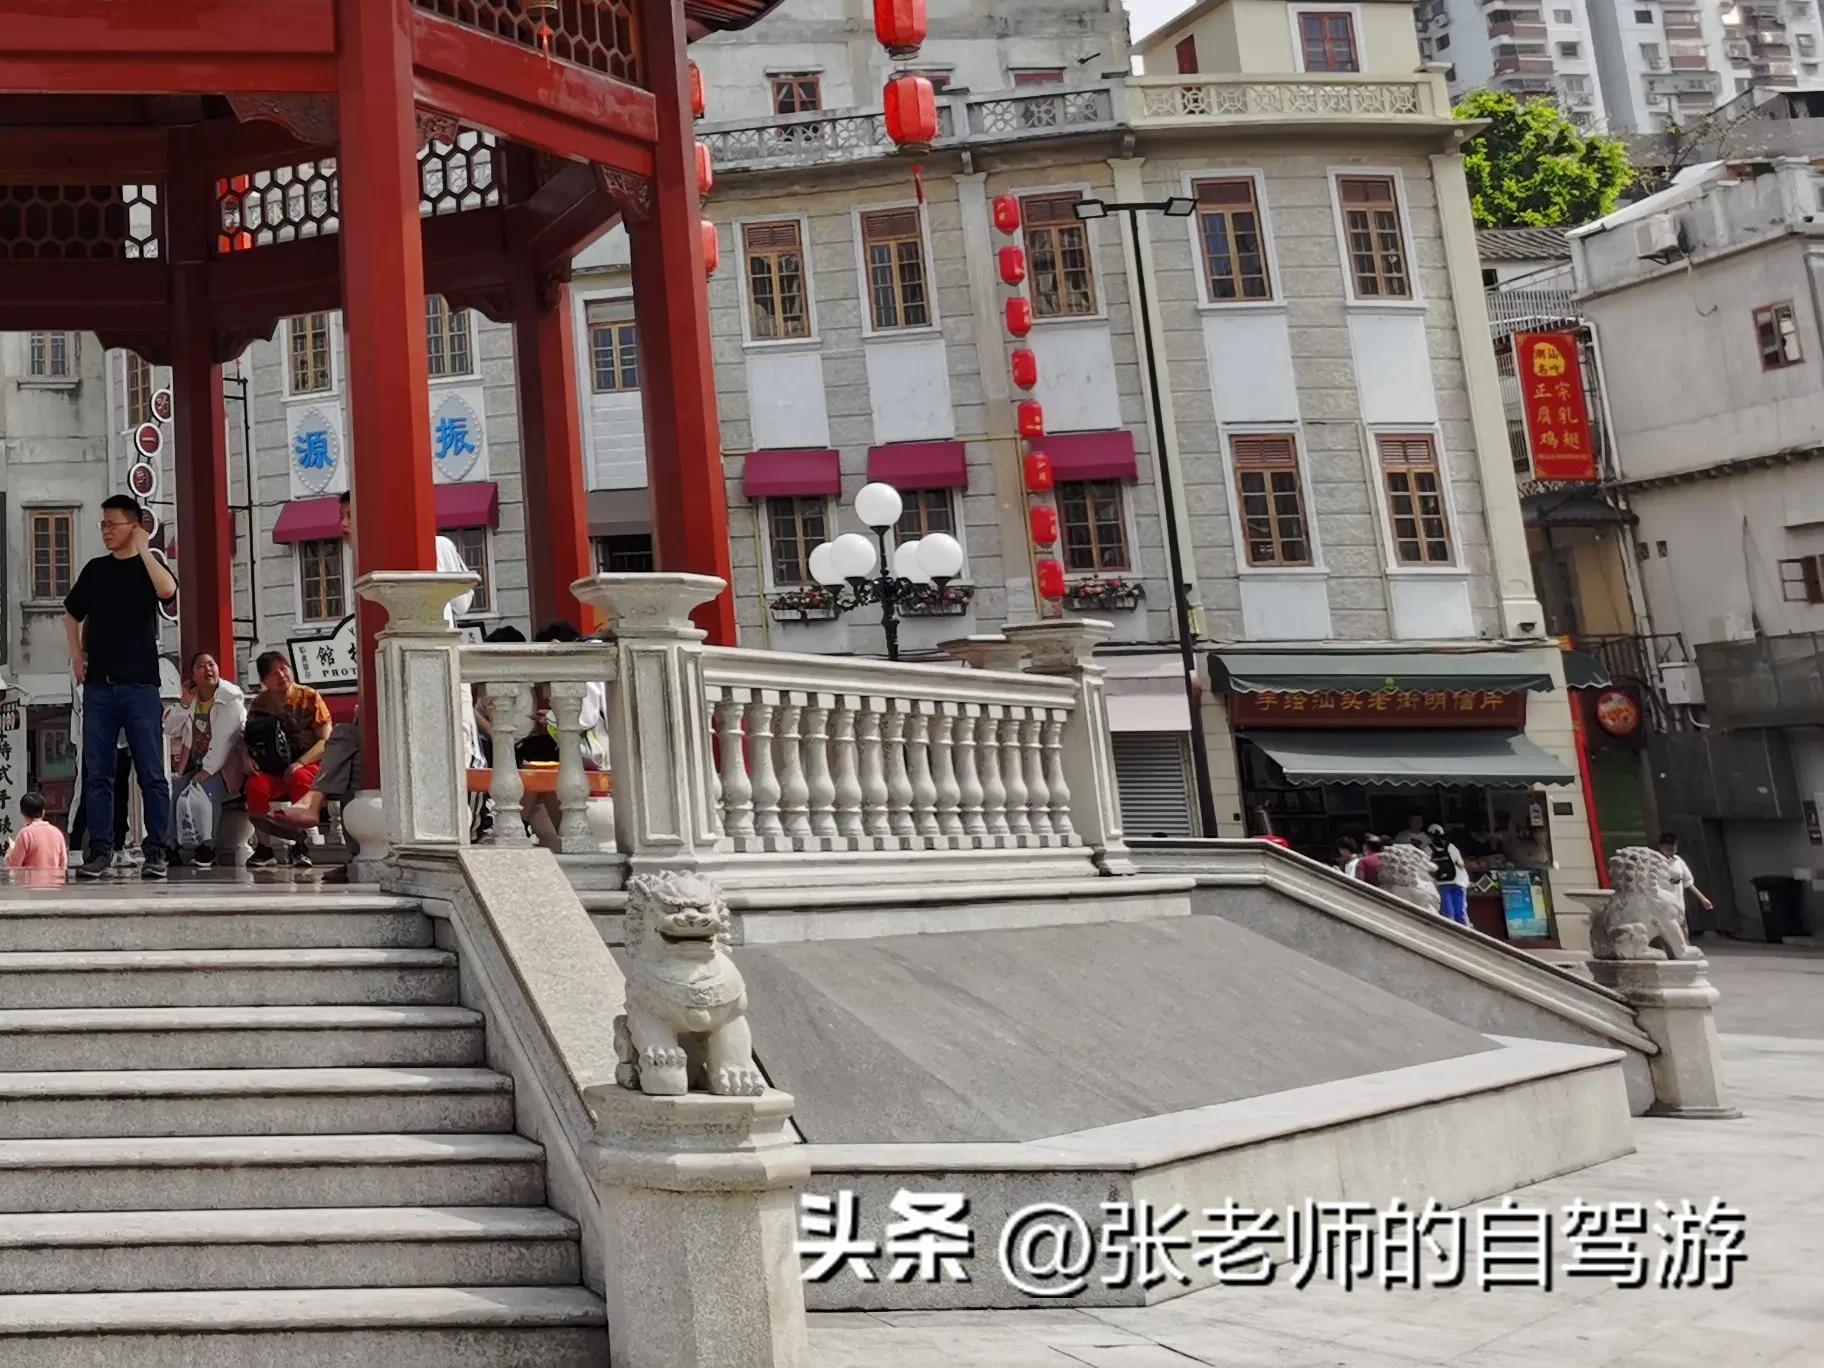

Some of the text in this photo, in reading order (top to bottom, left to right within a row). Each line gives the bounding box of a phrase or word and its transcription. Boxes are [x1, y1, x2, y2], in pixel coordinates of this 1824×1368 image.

[1533, 381, 1571, 402] 正宗
[1536, 406, 1579, 424] 腐乳
[1538, 429, 1581, 450] 鸡翅
[1254, 693, 1505, 711] 手绘汕头老街明信片
